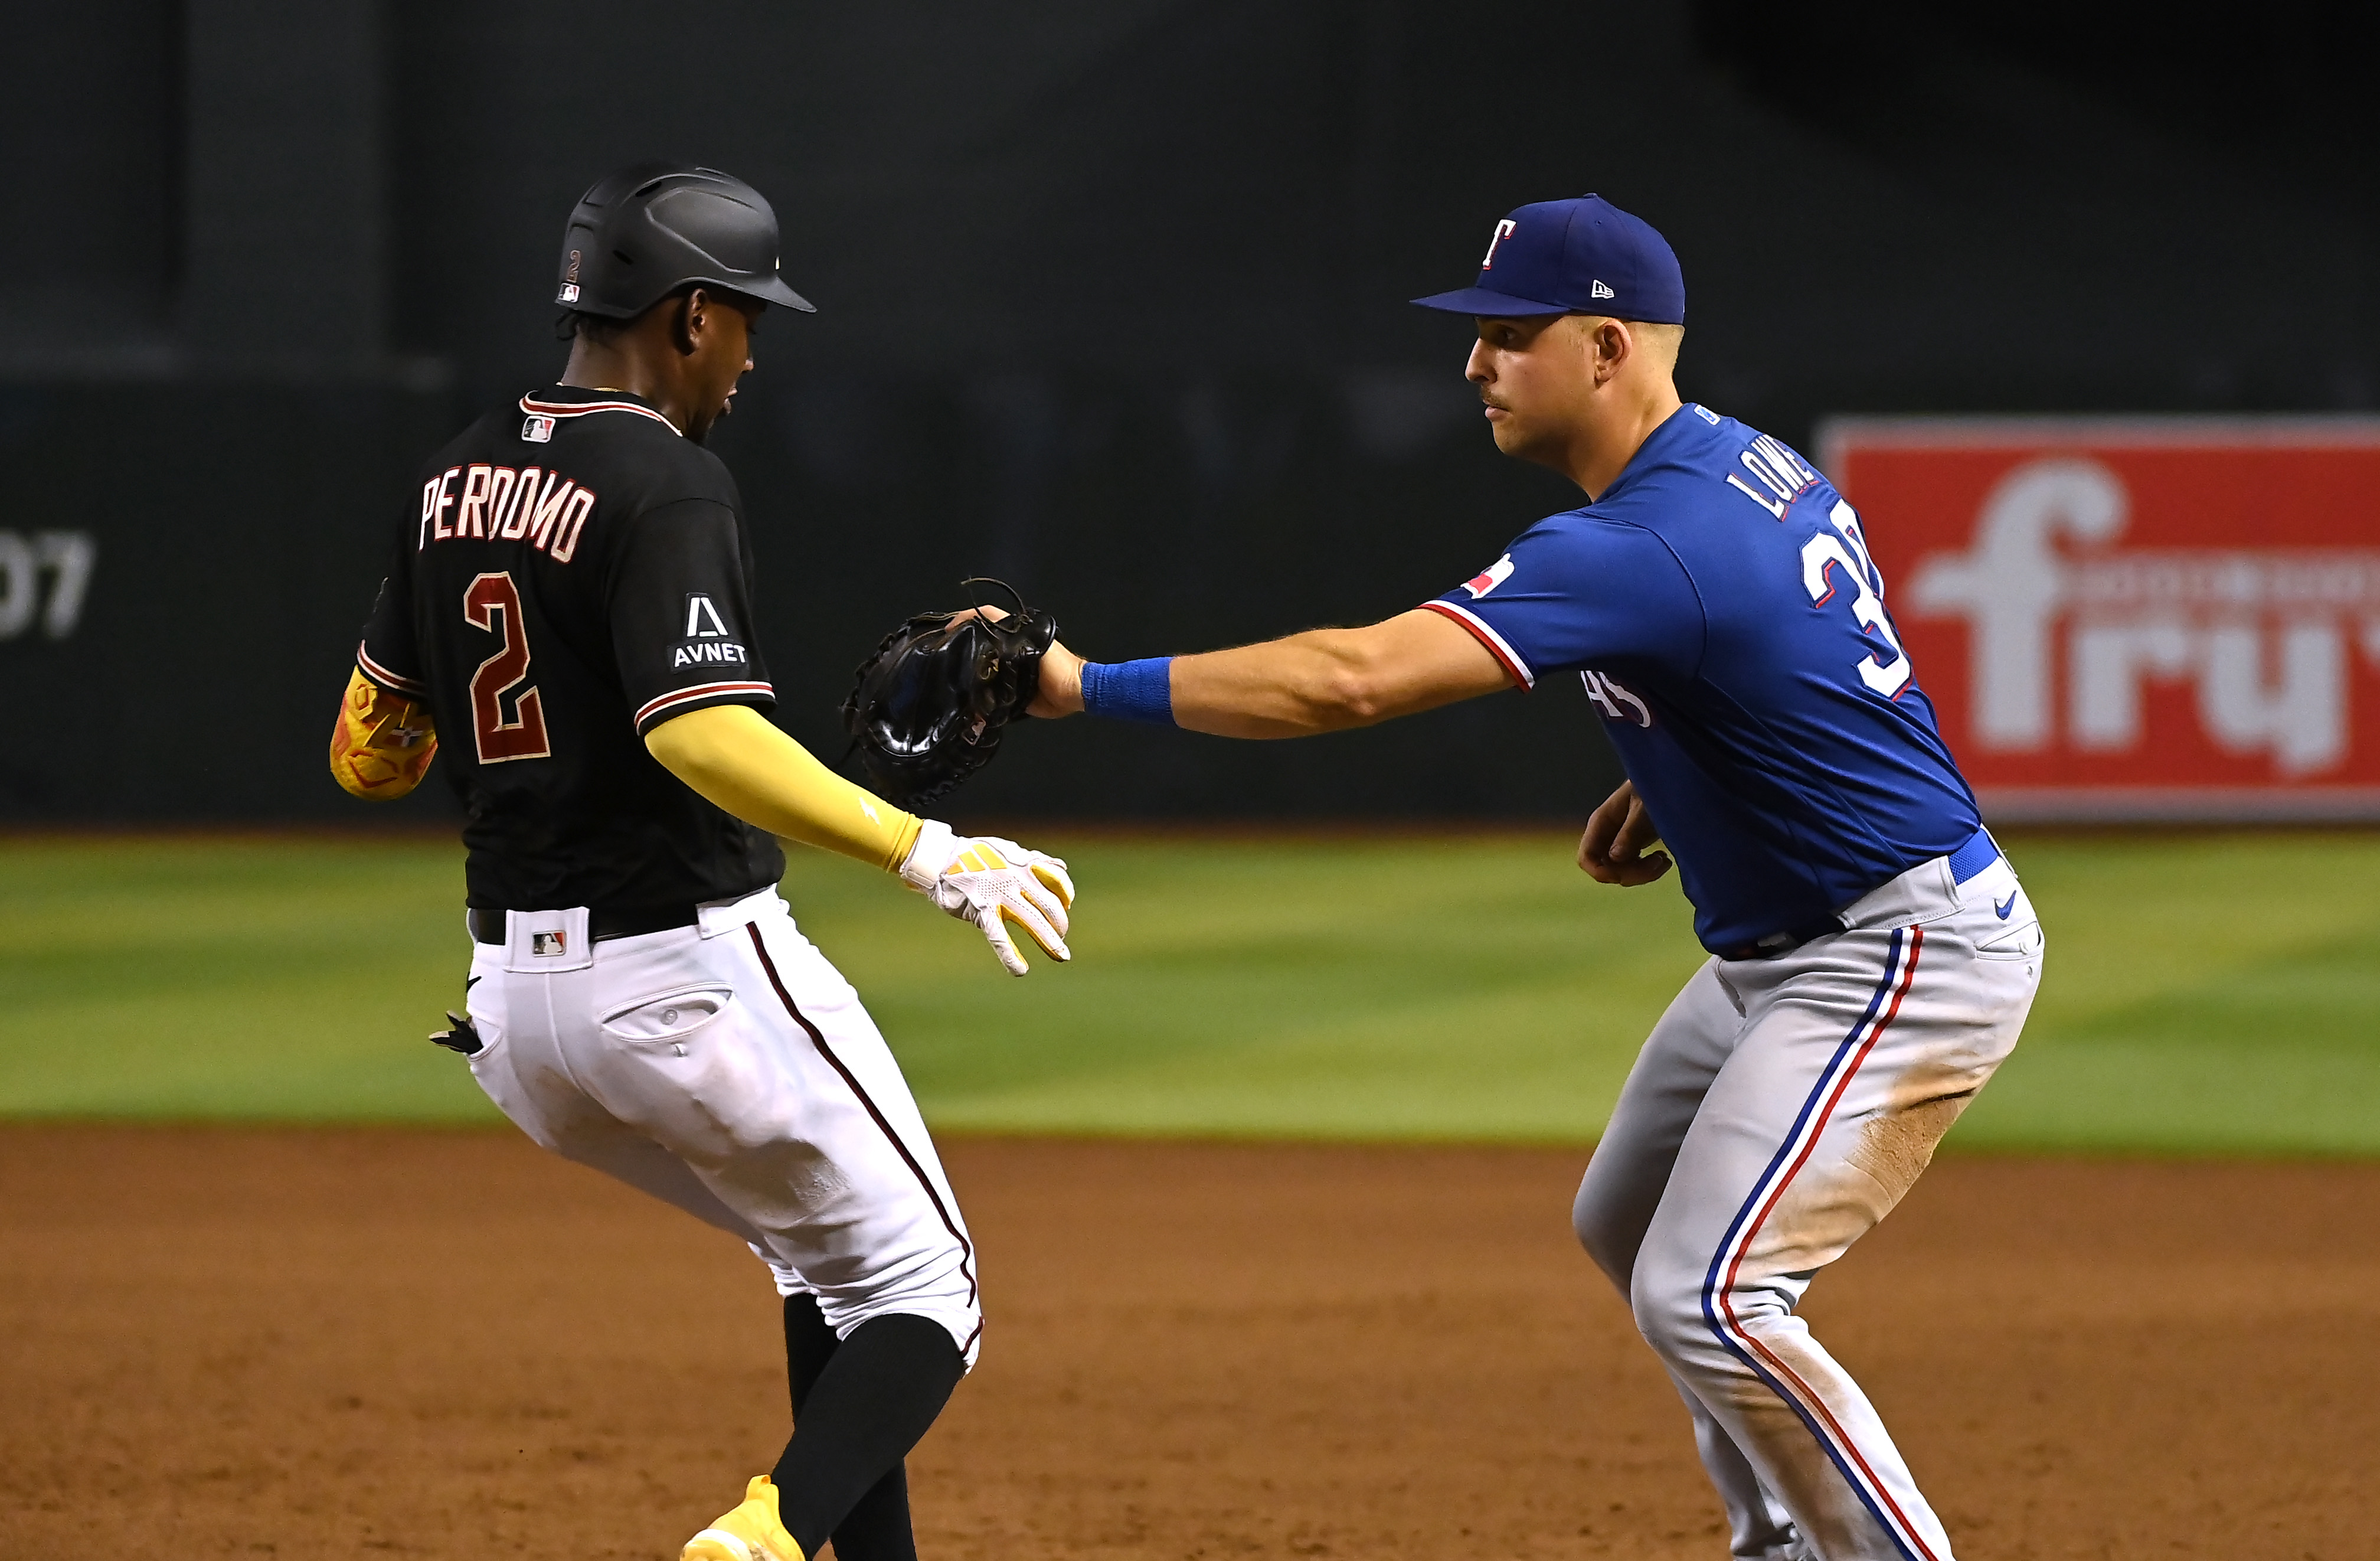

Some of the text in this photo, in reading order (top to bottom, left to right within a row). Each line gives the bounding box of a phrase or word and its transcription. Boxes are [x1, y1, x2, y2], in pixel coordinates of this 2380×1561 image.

[1482, 219, 1517, 270] T
[419, 463, 596, 564] PERDOMO
[464, 571, 551, 764] 2
[674, 642, 746, 668] AVNET
